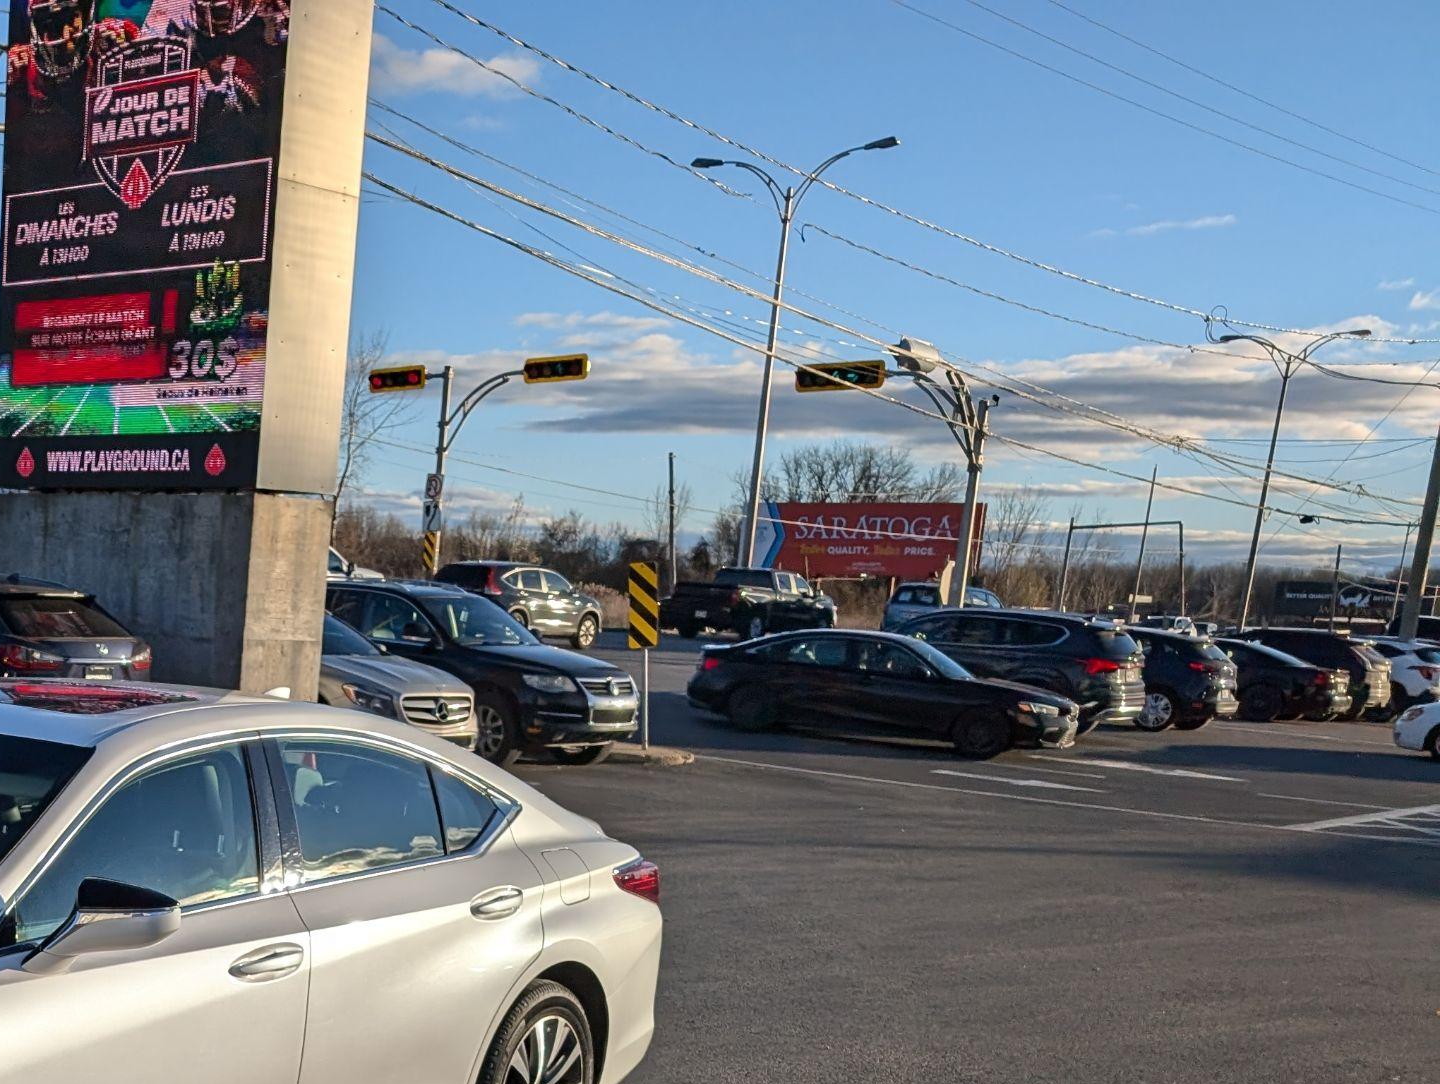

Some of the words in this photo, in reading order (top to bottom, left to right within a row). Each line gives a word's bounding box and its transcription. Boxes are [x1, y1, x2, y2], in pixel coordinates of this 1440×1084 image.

[109, 91, 159, 115] JOUR
[164, 86, 191, 106] DE
[92, 107, 191, 144] MATCH
[190, 185, 210, 198] LES
[59, 201, 76, 215] LES
[160, 195, 237, 228] LUNDIS
[15, 211, 120, 245] DIMANCHES
[183, 231, 226, 251] 19H00
[52, 245, 90, 265] 13H00
[168, 336, 240, 383] 30$
[46, 449, 191, 472] WWW.PLAYGROUND.CA
[795, 514, 953, 541] SARATOGA
